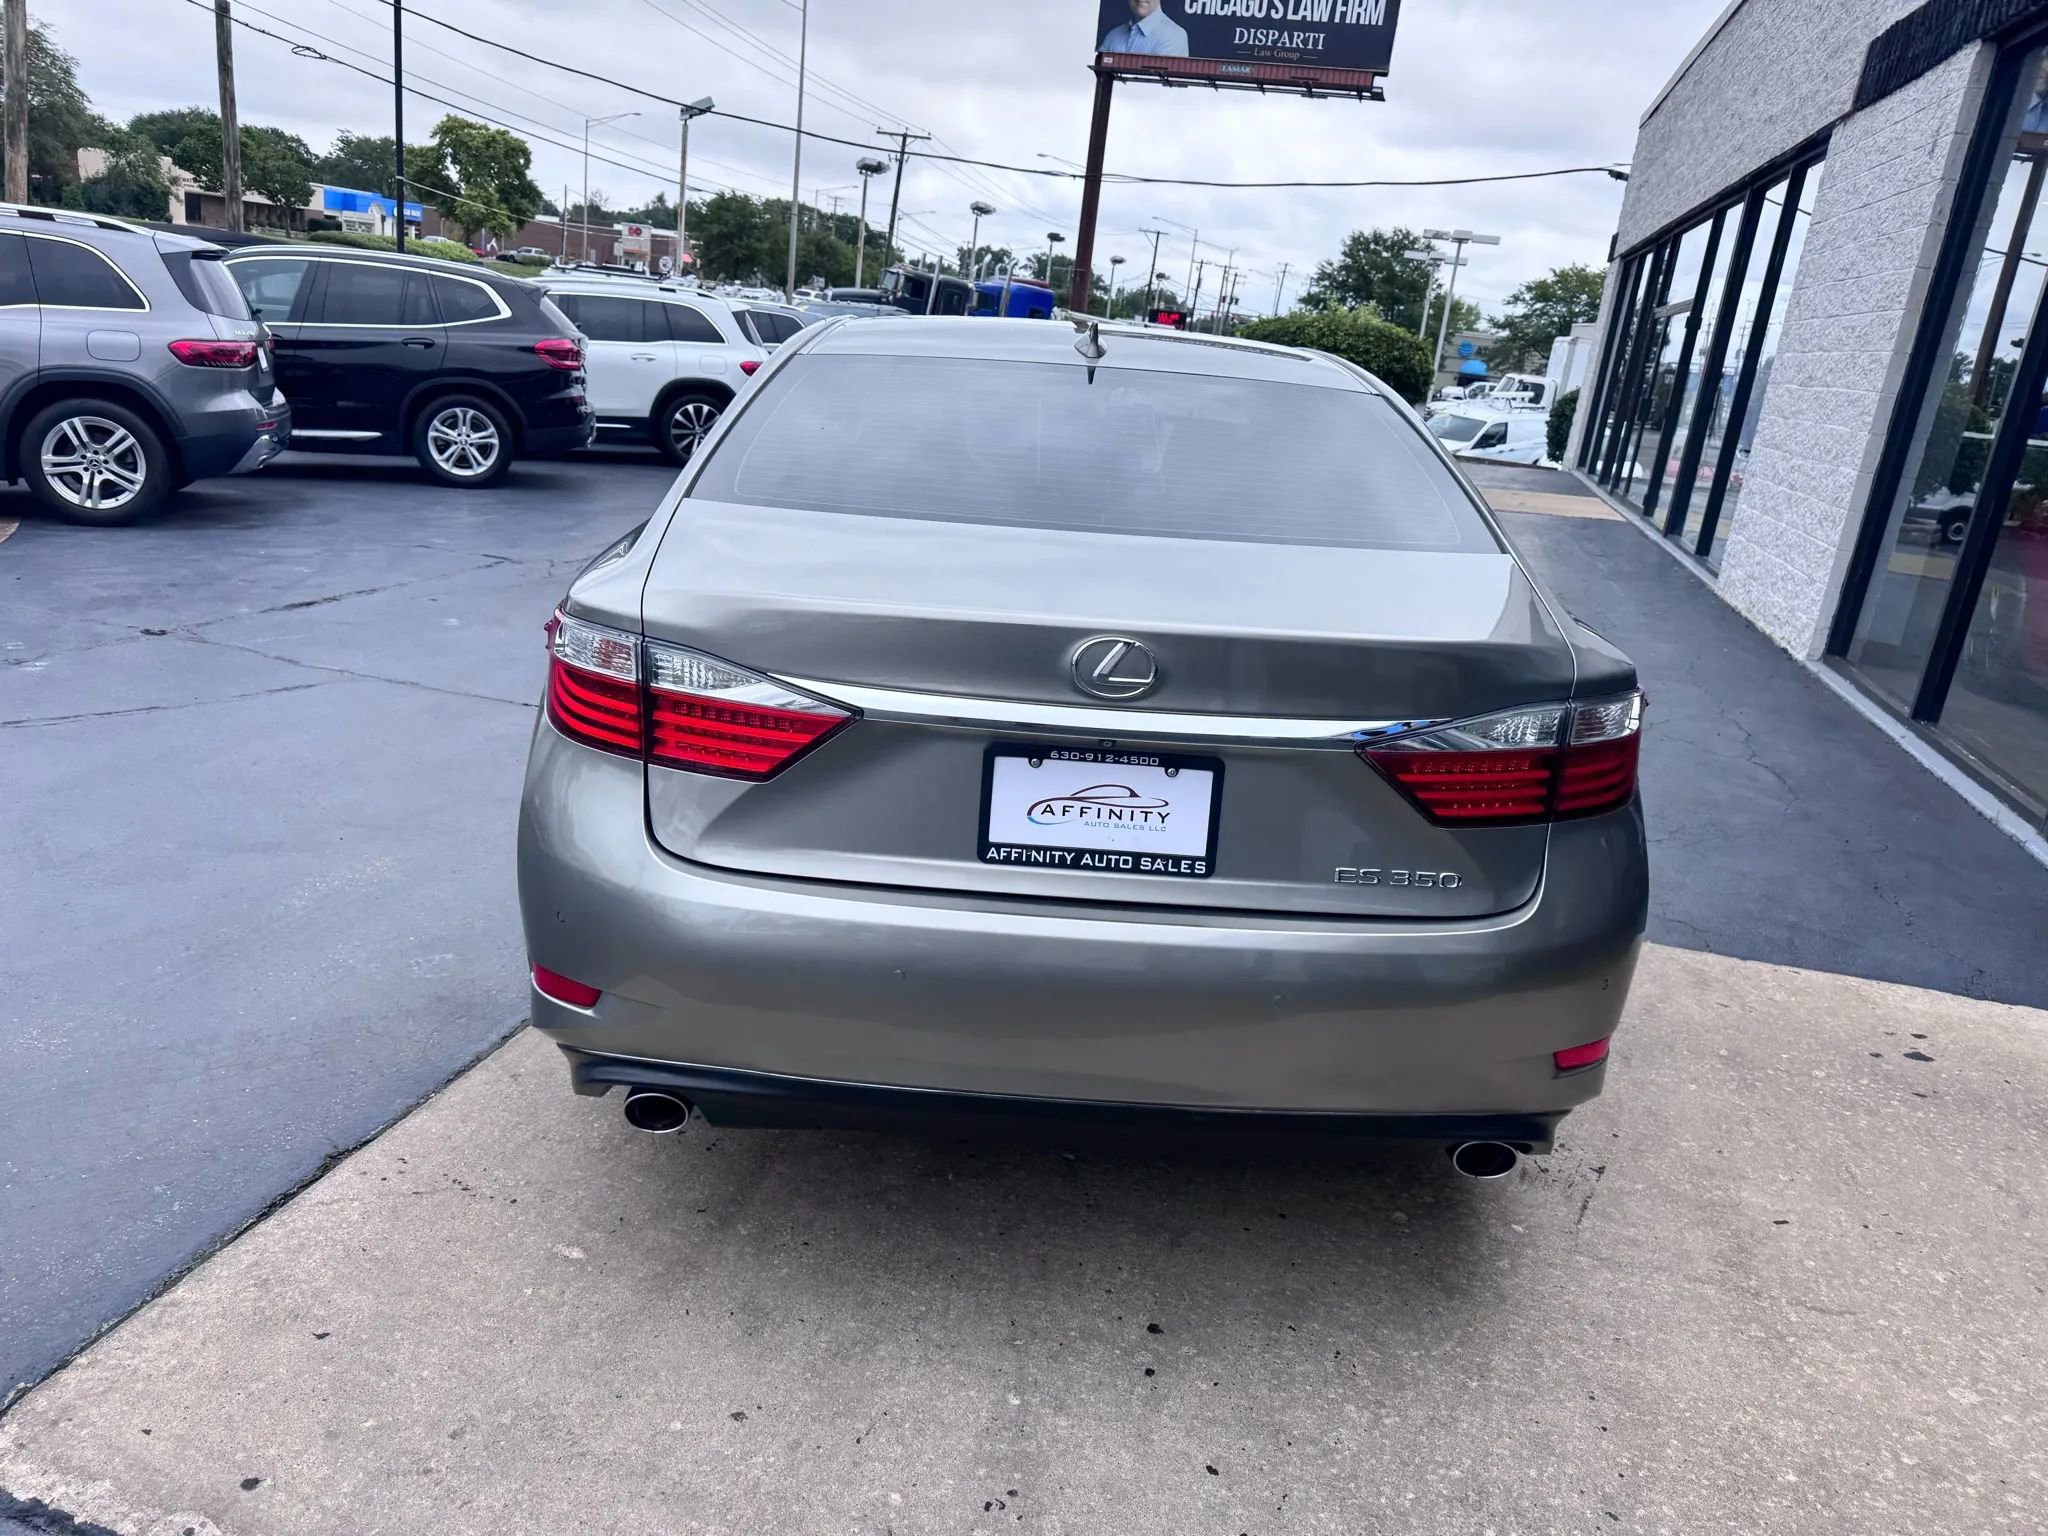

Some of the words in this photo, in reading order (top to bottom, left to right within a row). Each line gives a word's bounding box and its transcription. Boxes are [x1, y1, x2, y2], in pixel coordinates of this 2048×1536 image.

[1184, 0, 1285, 19] CHICAGOS
[1286, 0, 1333, 22] LAW
[1334, 0, 1387, 26] FIRM
[1233, 27, 1326, 50] DISPARTI
[1254, 47, 1272, 56] Law
[1274, 48, 1300, 60] Group
[1050, 750, 1159, 765] 630-912-4500
[1041, 803, 1170, 824] AFFINITY
[1114, 822, 1145, 831] SALES
[986, 847, 1075, 865] AFFINITY
[1080, 853, 1132, 869] AUTO
[1139, 857, 1207, 874] SALES
[1334, 867, 1381, 884] ES
[1389, 869, 1462, 888] 350
